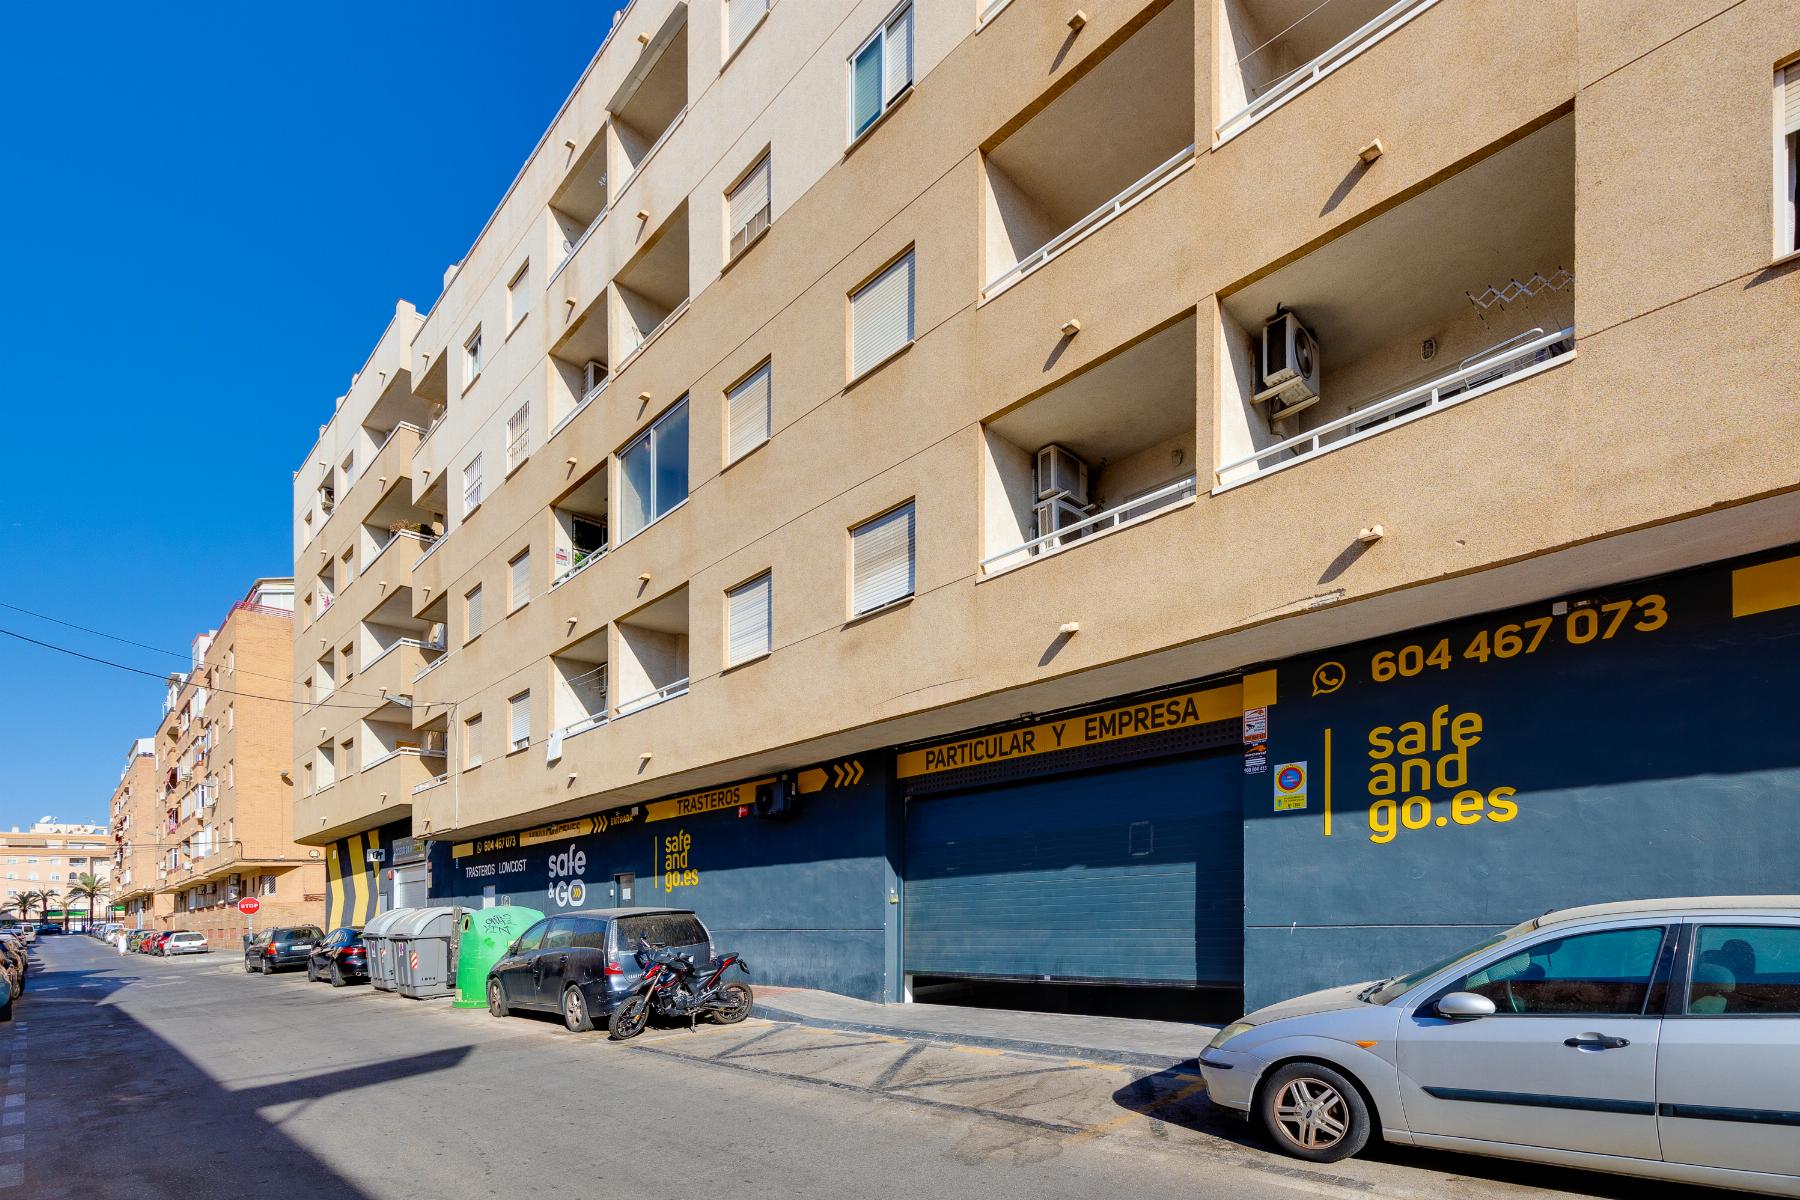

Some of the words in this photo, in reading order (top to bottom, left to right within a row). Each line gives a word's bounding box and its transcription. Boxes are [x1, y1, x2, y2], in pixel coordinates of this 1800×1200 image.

[1371, 638, 1452, 683] 604
[1463, 616, 1554, 663] 467
[1566, 594, 1669, 645] 073
[925, 730, 1035, 771] PARTICULAR
[1051, 723, 1067, 747] Y
[1084, 696, 1200, 742] EMPRESA
[1367, 703, 1484, 760] safe
[1367, 746, 1469, 797] and
[677, 787, 741, 815] TRASTEROS
[1367, 785, 1519, 845] go.es
[610, 813, 634, 826] ENTRADA
[484, 839, 496, 852] 604
[495, 837, 506, 850] 467
[505, 834, 517, 848] 073
[665, 828, 692, 853] safe
[466, 863, 496, 878] TRASTEROS
[498, 858, 527, 875] LOWCOST
[548, 843, 587, 878] safe
[665, 848, 688, 871] and
[665, 867, 699, 893] go.es
